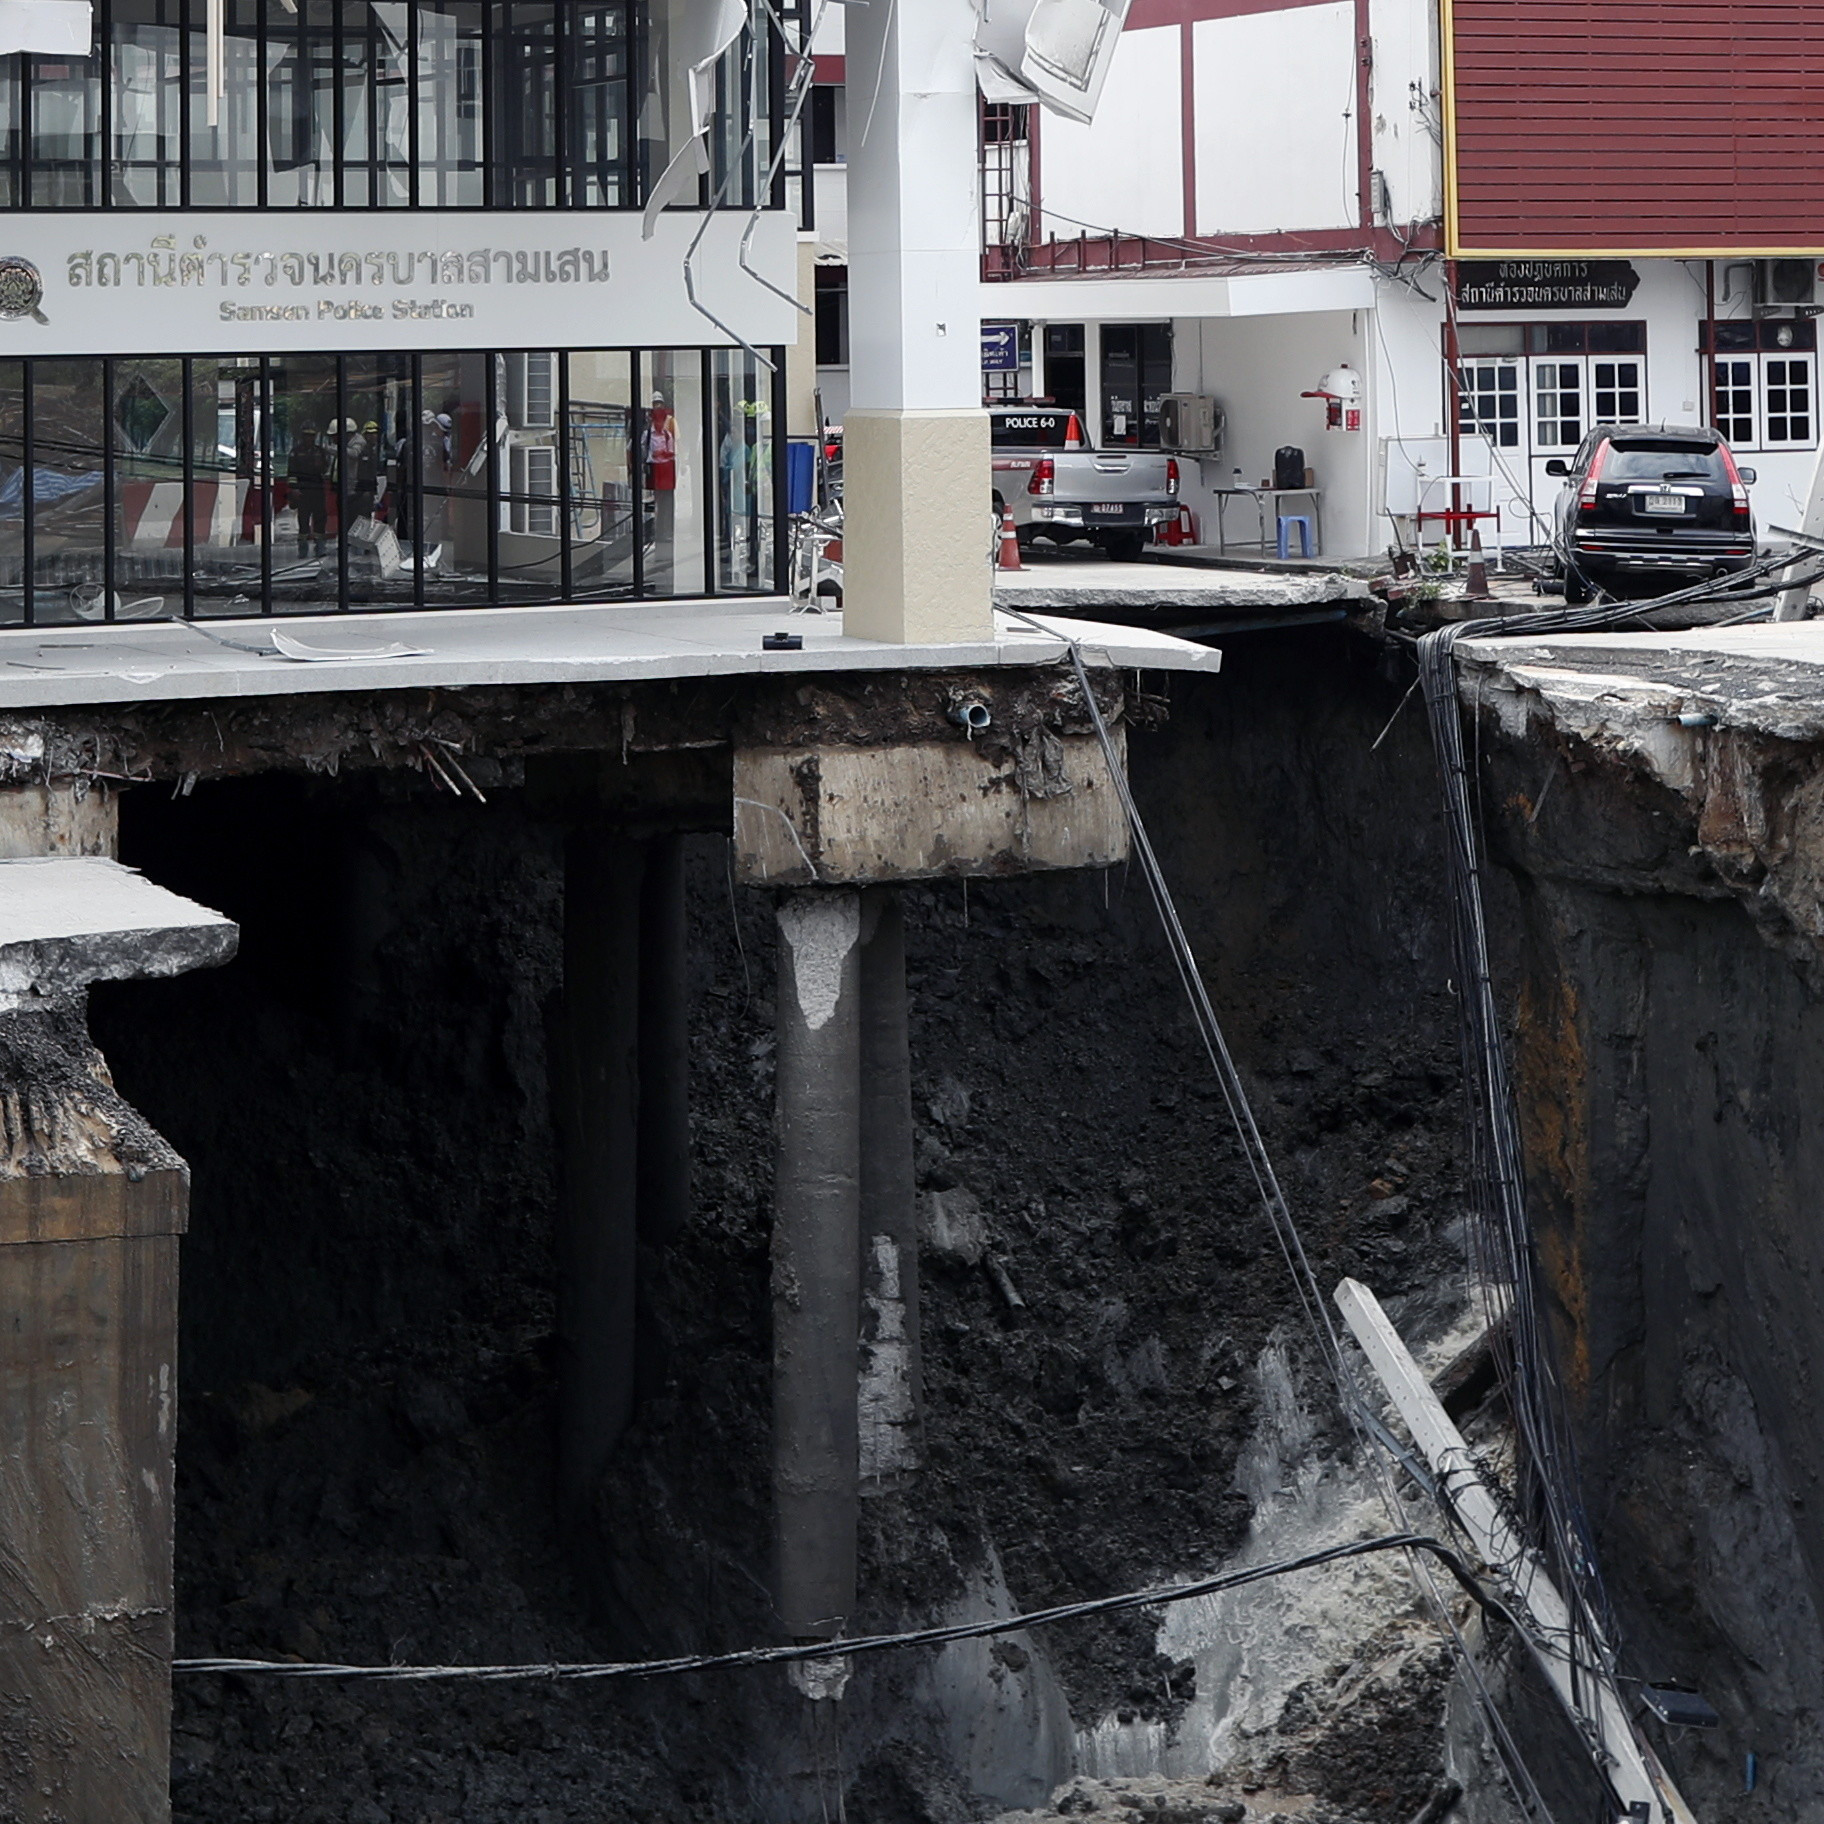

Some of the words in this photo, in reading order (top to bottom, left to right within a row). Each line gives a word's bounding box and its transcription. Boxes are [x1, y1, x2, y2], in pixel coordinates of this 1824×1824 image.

[66, 233, 610, 287] สถานีตำรวจนครบาลสามเสน
[219, 300, 309, 321] Samsen
[317, 300, 385, 321] Police
[392, 299, 475, 320] Station
[1005, 417, 1038, 428] POLICE
[1040, 417, 1055, 428] 6-0
